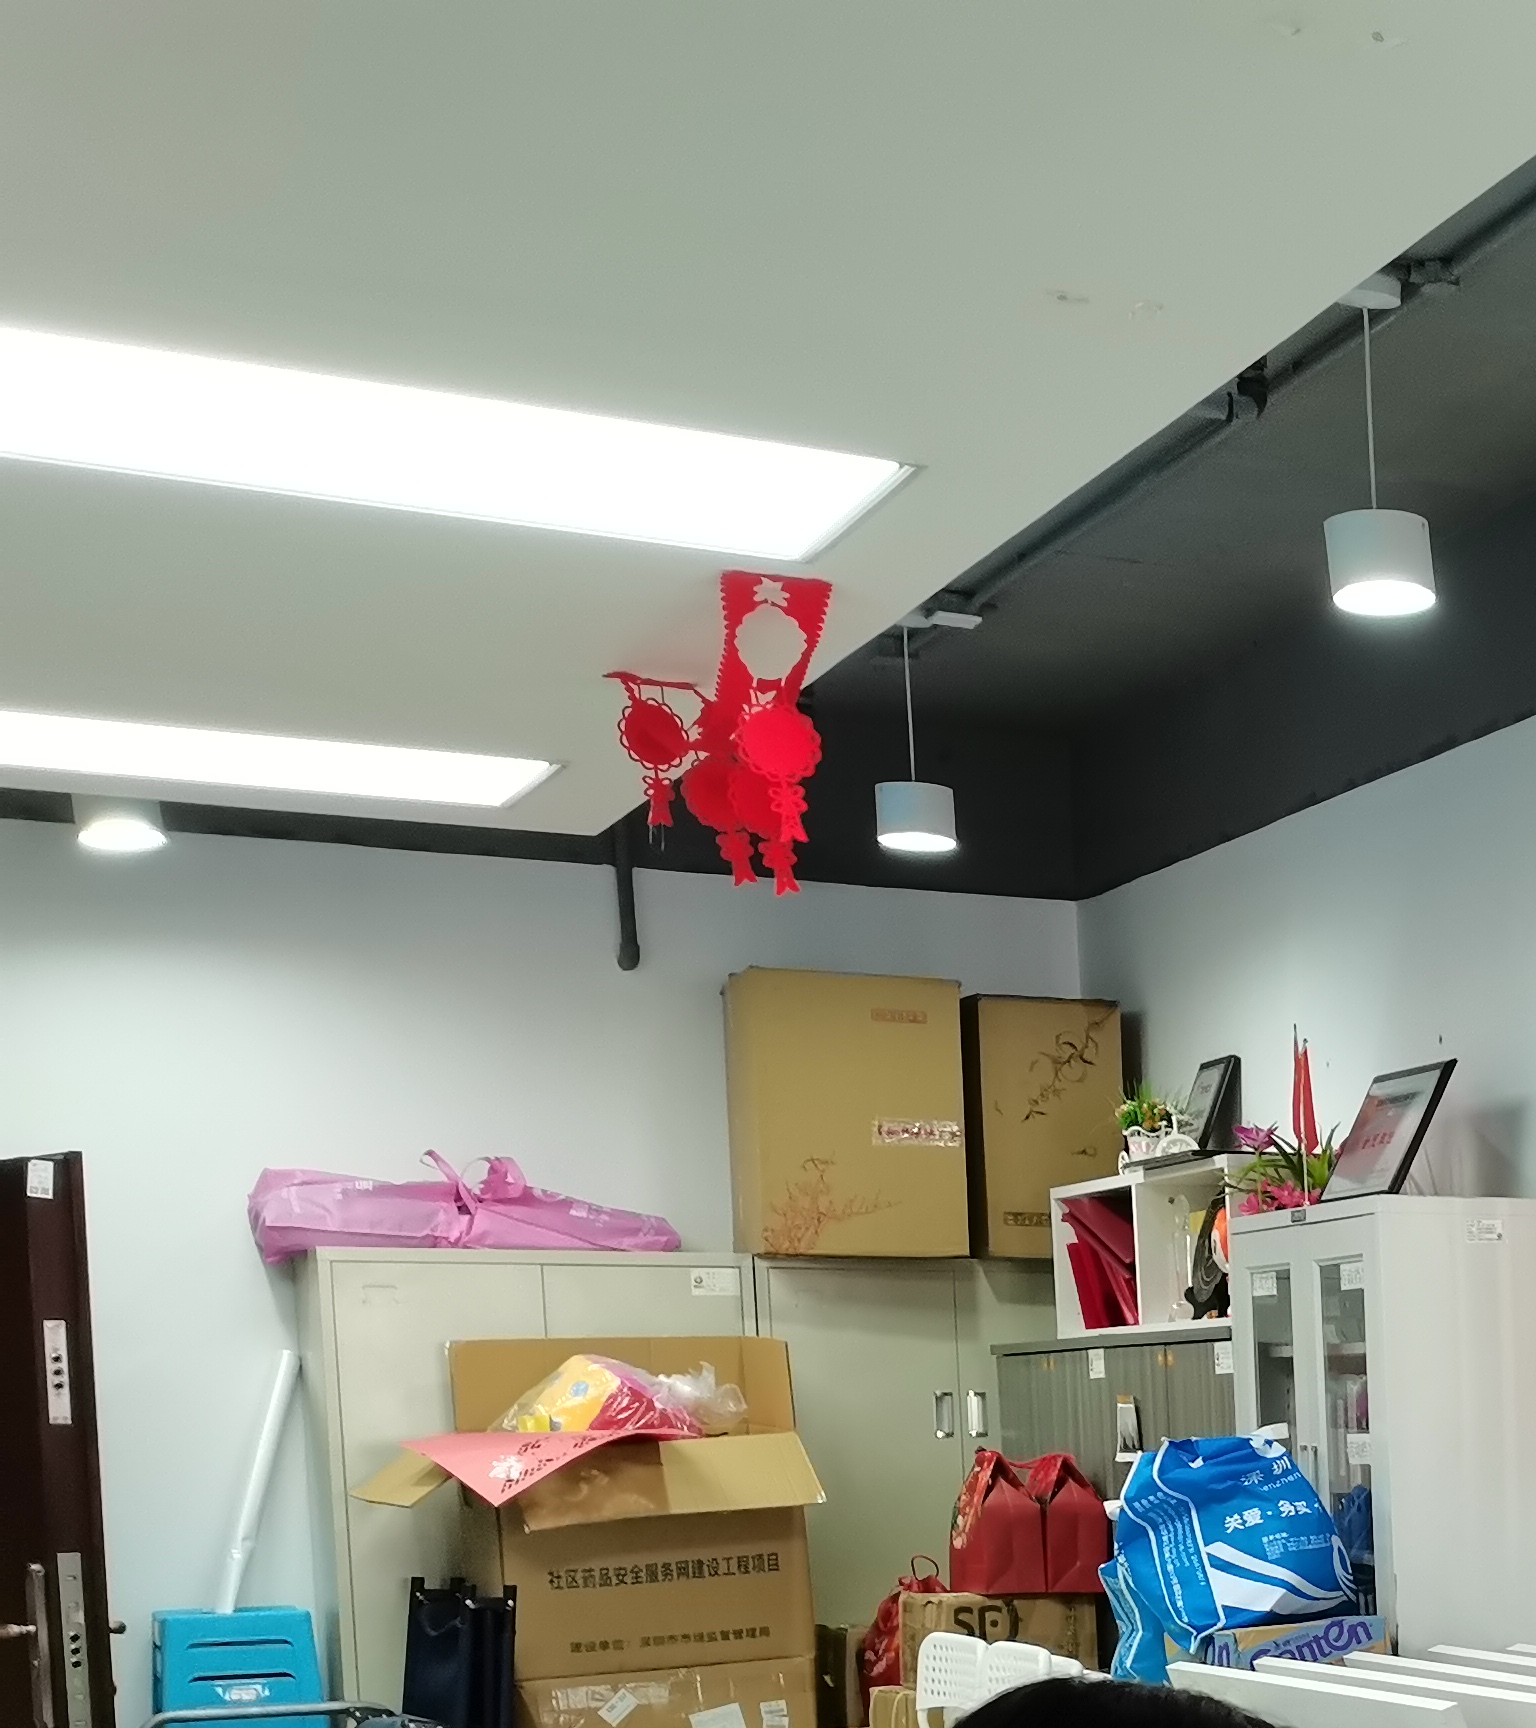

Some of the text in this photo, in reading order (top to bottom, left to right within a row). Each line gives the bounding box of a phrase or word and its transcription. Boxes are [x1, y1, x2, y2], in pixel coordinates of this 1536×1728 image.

[548, 1552, 780, 1592] 社区药品安全服务网建设工程项目
